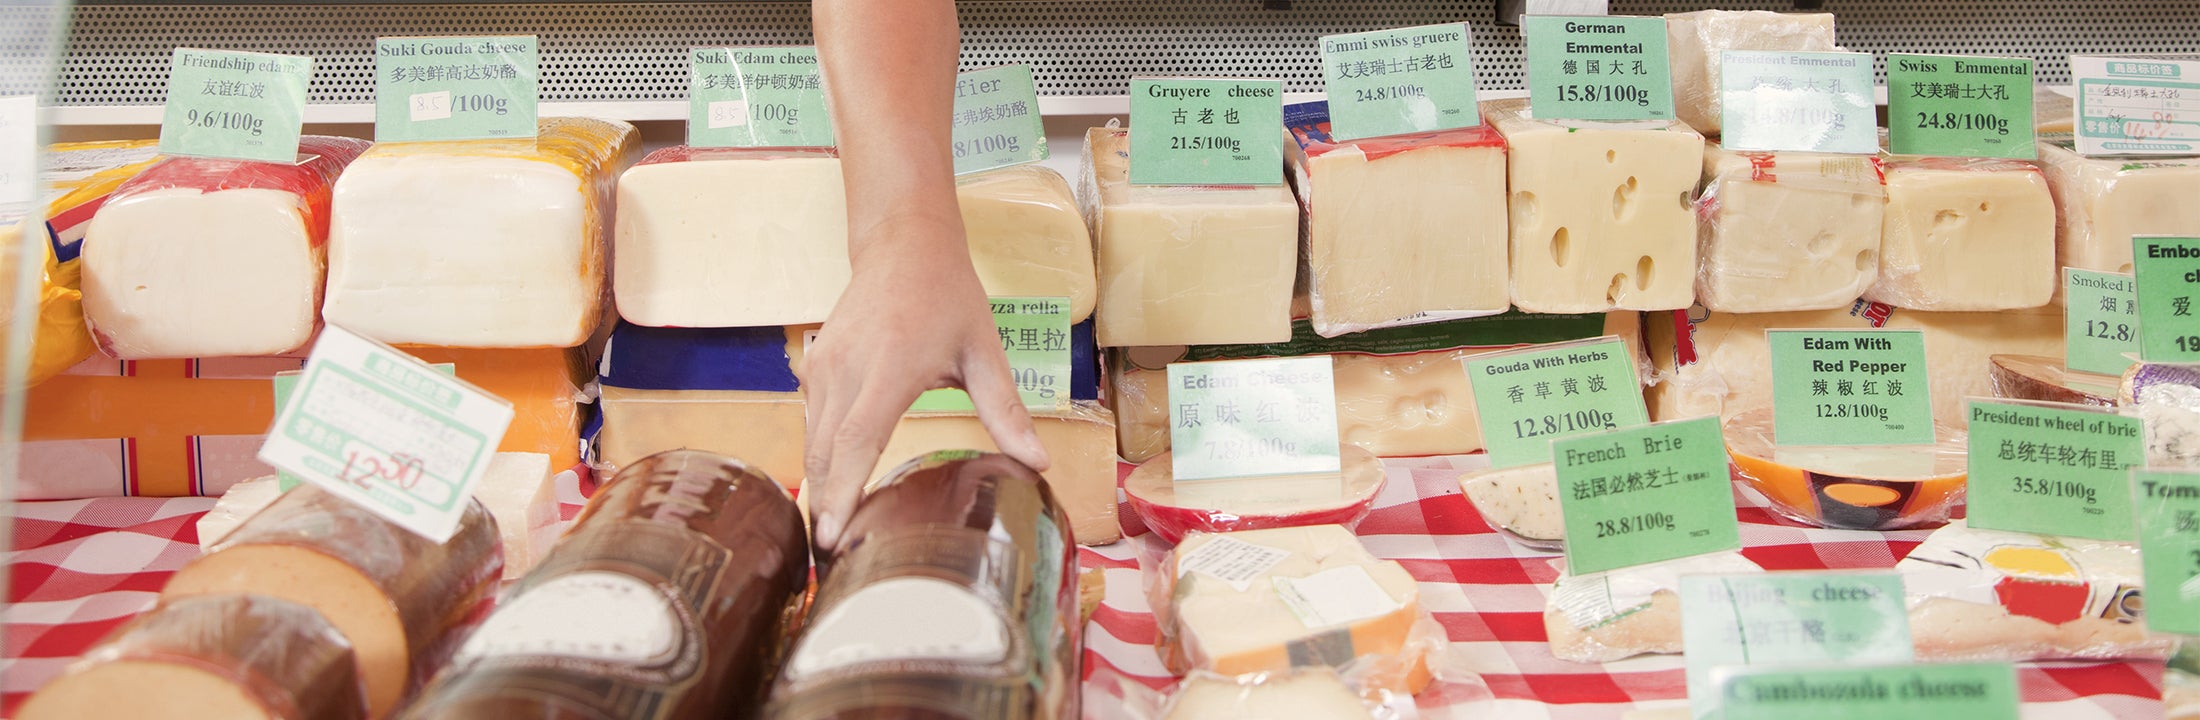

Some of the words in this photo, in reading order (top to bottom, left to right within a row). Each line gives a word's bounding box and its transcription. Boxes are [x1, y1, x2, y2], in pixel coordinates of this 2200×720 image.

[1565, 22, 1627, 33] German
[381, 43, 416, 57] Suki
[422, 42, 472, 56] Gouda
[478, 42, 526, 54] cheese
[1326, 37, 1369, 54] Emmi
[1372, 35, 1409, 49] swiss
[1413, 32, 1460, 48] gruere
[1566, 42, 1643, 54] Emmental
[183, 53, 254, 73] Friendship
[259, 60, 296, 73] edam
[696, 51, 728, 65] Suki
[734, 52, 775, 65] Edam
[1336, 53, 1454, 80] 艾美瑞士古老也
[1724, 54, 1786, 66] President
[1790, 56, 1856, 67] Emmental
[1899, 60, 1938, 73] Swiss
[1955, 61, 2027, 75] Emmental
[391, 64, 517, 84] 多美鲜高达奶酪
[1562, 60, 1648, 76] 德国大孔
[201, 78, 265, 99] 友谊红波
[1149, 85, 1211, 101] Gruyere
[1228, 85, 1274, 98] cheese
[1356, 84, 1425, 103] 24.8/100g
[1557, 85, 1649, 107] 15.8/100g
[1911, 82, 2009, 101] 艾美瑞士大孔
[416, 96, 443, 111] 8.5
[450, 94, 508, 116] /100g
[188, 109, 263, 136] 9.6/100g
[1172, 108, 1240, 125] 古老也
[1917, 112, 2009, 136] 24.8/100g
[1171, 136, 1241, 153] 21.5/100g
[2148, 244, 2200, 258] Embo
[2072, 274, 2123, 292] Smoked
[1022, 301, 1059, 315] rella
[2172, 296, 2192, 317] 爱
[998, 327, 1067, 351] 苏里拉
[2085, 319, 2136, 343] 12.8/
[1804, 338, 1849, 350] Edam
[1854, 338, 1892, 350] With
[1486, 361, 1530, 375] Gouda
[1533, 355, 1565, 369] With
[1568, 350, 1608, 365] Herbs
[1813, 360, 1843, 372] Red
[1849, 360, 1906, 375] Pepper
[1183, 374, 1240, 389] Edam
[1507, 374, 1607, 404] 香草黄波
[1812, 379, 1903, 397] 辣椒红波
[1178, 397, 1321, 429] 原味红波
[1816, 404, 1889, 422] 12.8/100g
[1973, 407, 2040, 427] President
[2045, 416, 2085, 432] wheel
[2090, 421, 2104, 434] of
[2108, 421, 2137, 437] brie
[1513, 409, 1617, 439] 12.8/100g
[1566, 442, 1626, 467] French
[1643, 435, 1683, 454] Brie
[1998, 439, 2119, 471] 总统车轮布里
[2013, 476, 2097, 504] 35.8/100g
[1595, 512, 1676, 538] 28.8/100g
[1811, 583, 1881, 601] cheese
